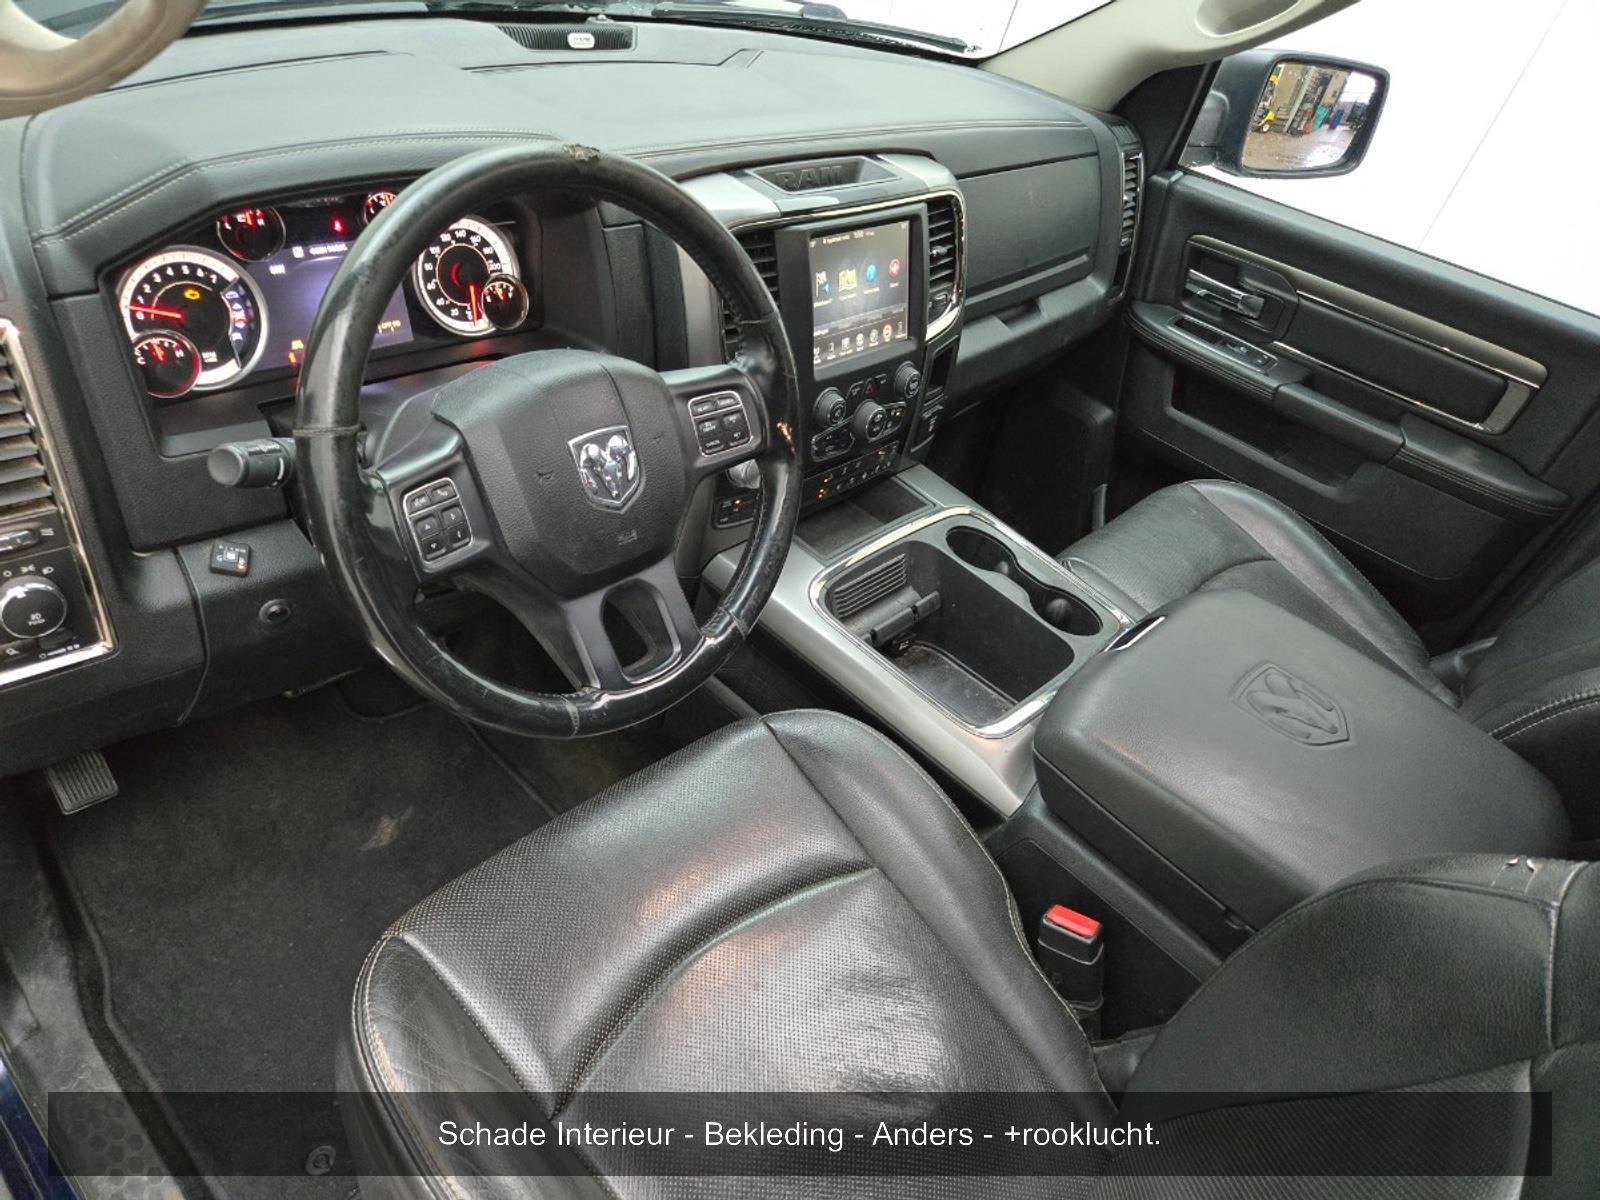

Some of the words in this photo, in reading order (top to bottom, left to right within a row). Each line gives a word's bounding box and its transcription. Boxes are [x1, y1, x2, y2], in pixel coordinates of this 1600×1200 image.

[774, 165, 842, 189] RAM
[166, 266, 174, 276] 4
[196, 267, 204, 277] 6
[143, 283, 152, 293] 2
